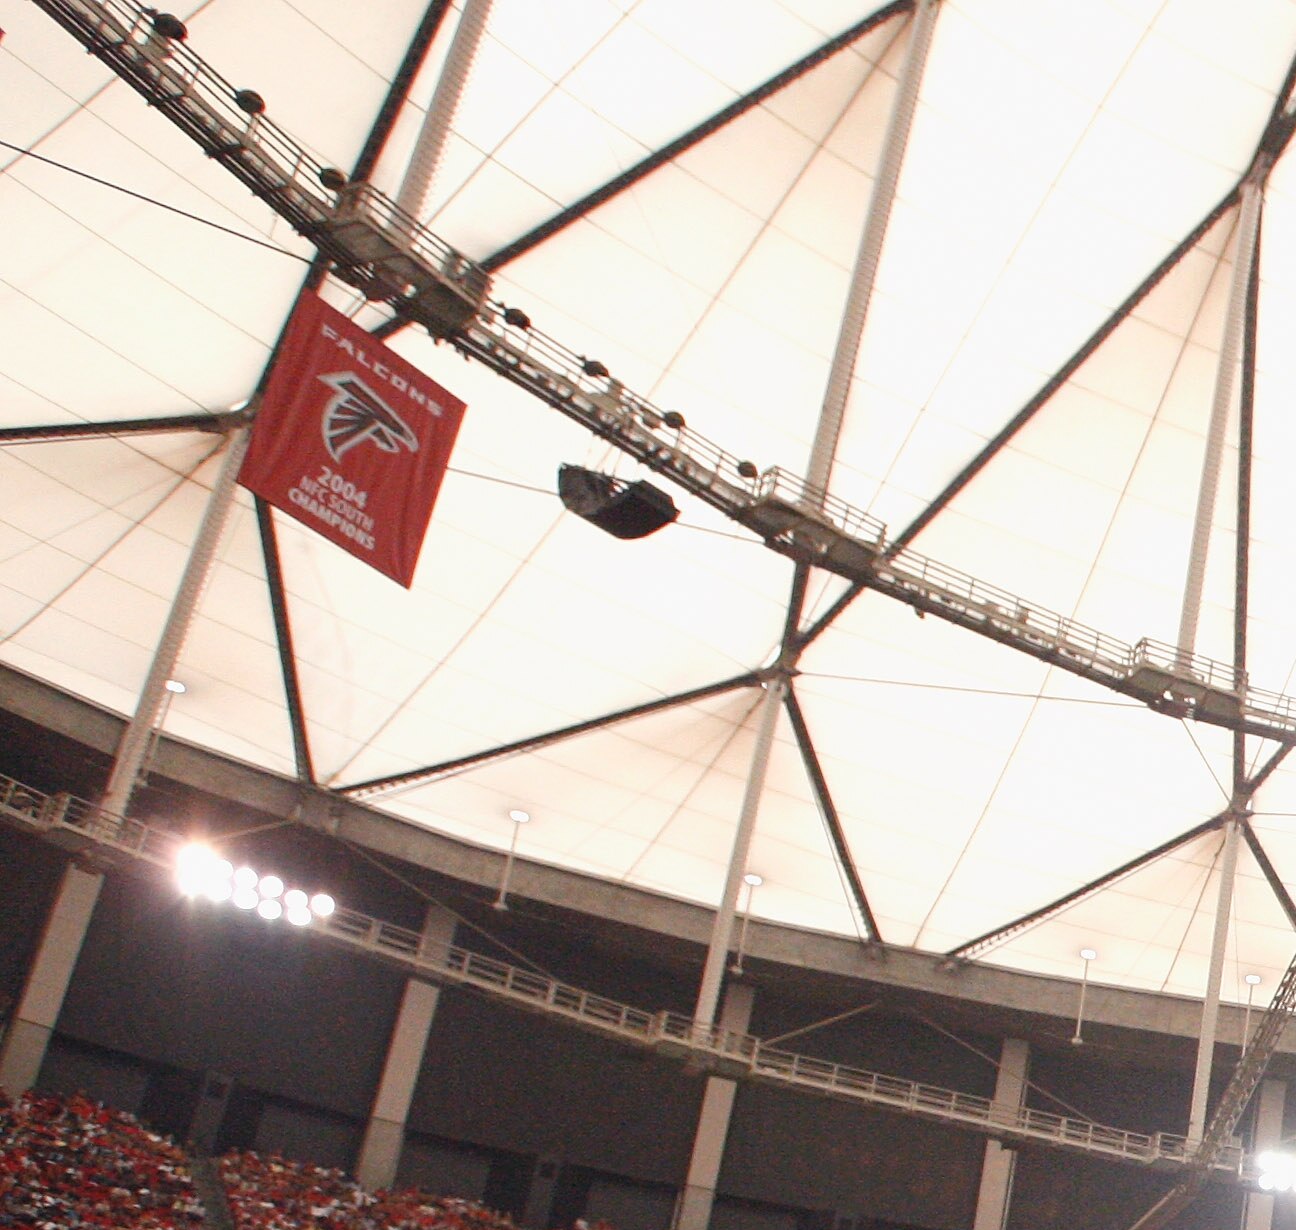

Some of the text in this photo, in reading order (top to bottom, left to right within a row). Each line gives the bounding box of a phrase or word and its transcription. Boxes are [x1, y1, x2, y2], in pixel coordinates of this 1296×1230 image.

[321, 323, 443, 418] FALCONS
[300, 475, 375, 532] NFC SOUTH
[317, 465, 368, 510] 2004
[288, 487, 376, 551] CHAMPIONS
